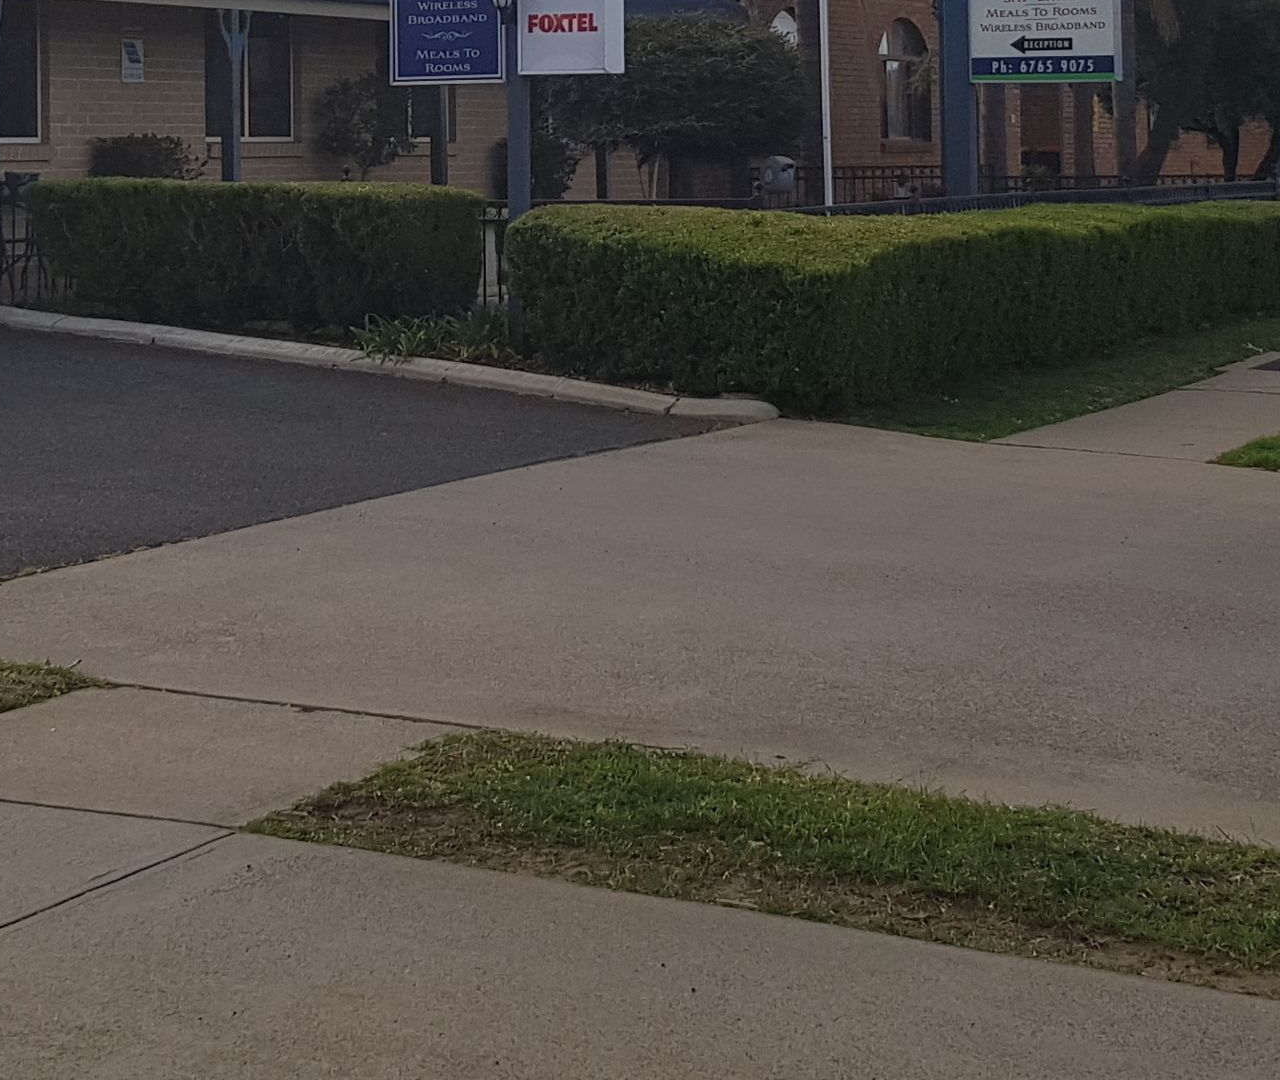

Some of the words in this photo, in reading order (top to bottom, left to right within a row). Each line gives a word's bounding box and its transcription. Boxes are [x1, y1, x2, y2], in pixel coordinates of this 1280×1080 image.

[416, 0, 478, 11] WIRELESS
[985, 8, 1029, 18] MEALS
[1031, 7, 1048, 17] TO
[1053, 6, 1097, 16] ROOMS
[408, 14, 488, 25] BROADBAND
[528, 13, 598, 33] FOXTEL
[980, 23, 1032, 33] WIRELESS
[1036, 21, 1106, 32] BROADBAND
[1023, 40, 1069, 49] RECEPTION
[416, 49, 460, 60] MEALS
[463, 48, 480, 58] TO
[425, 63, 471, 73] ROOMS
[992, 61, 1013, 73] Ph:
[1020, 60, 1053, 73] 6765
[1061, 59, 1094, 72] 9075
